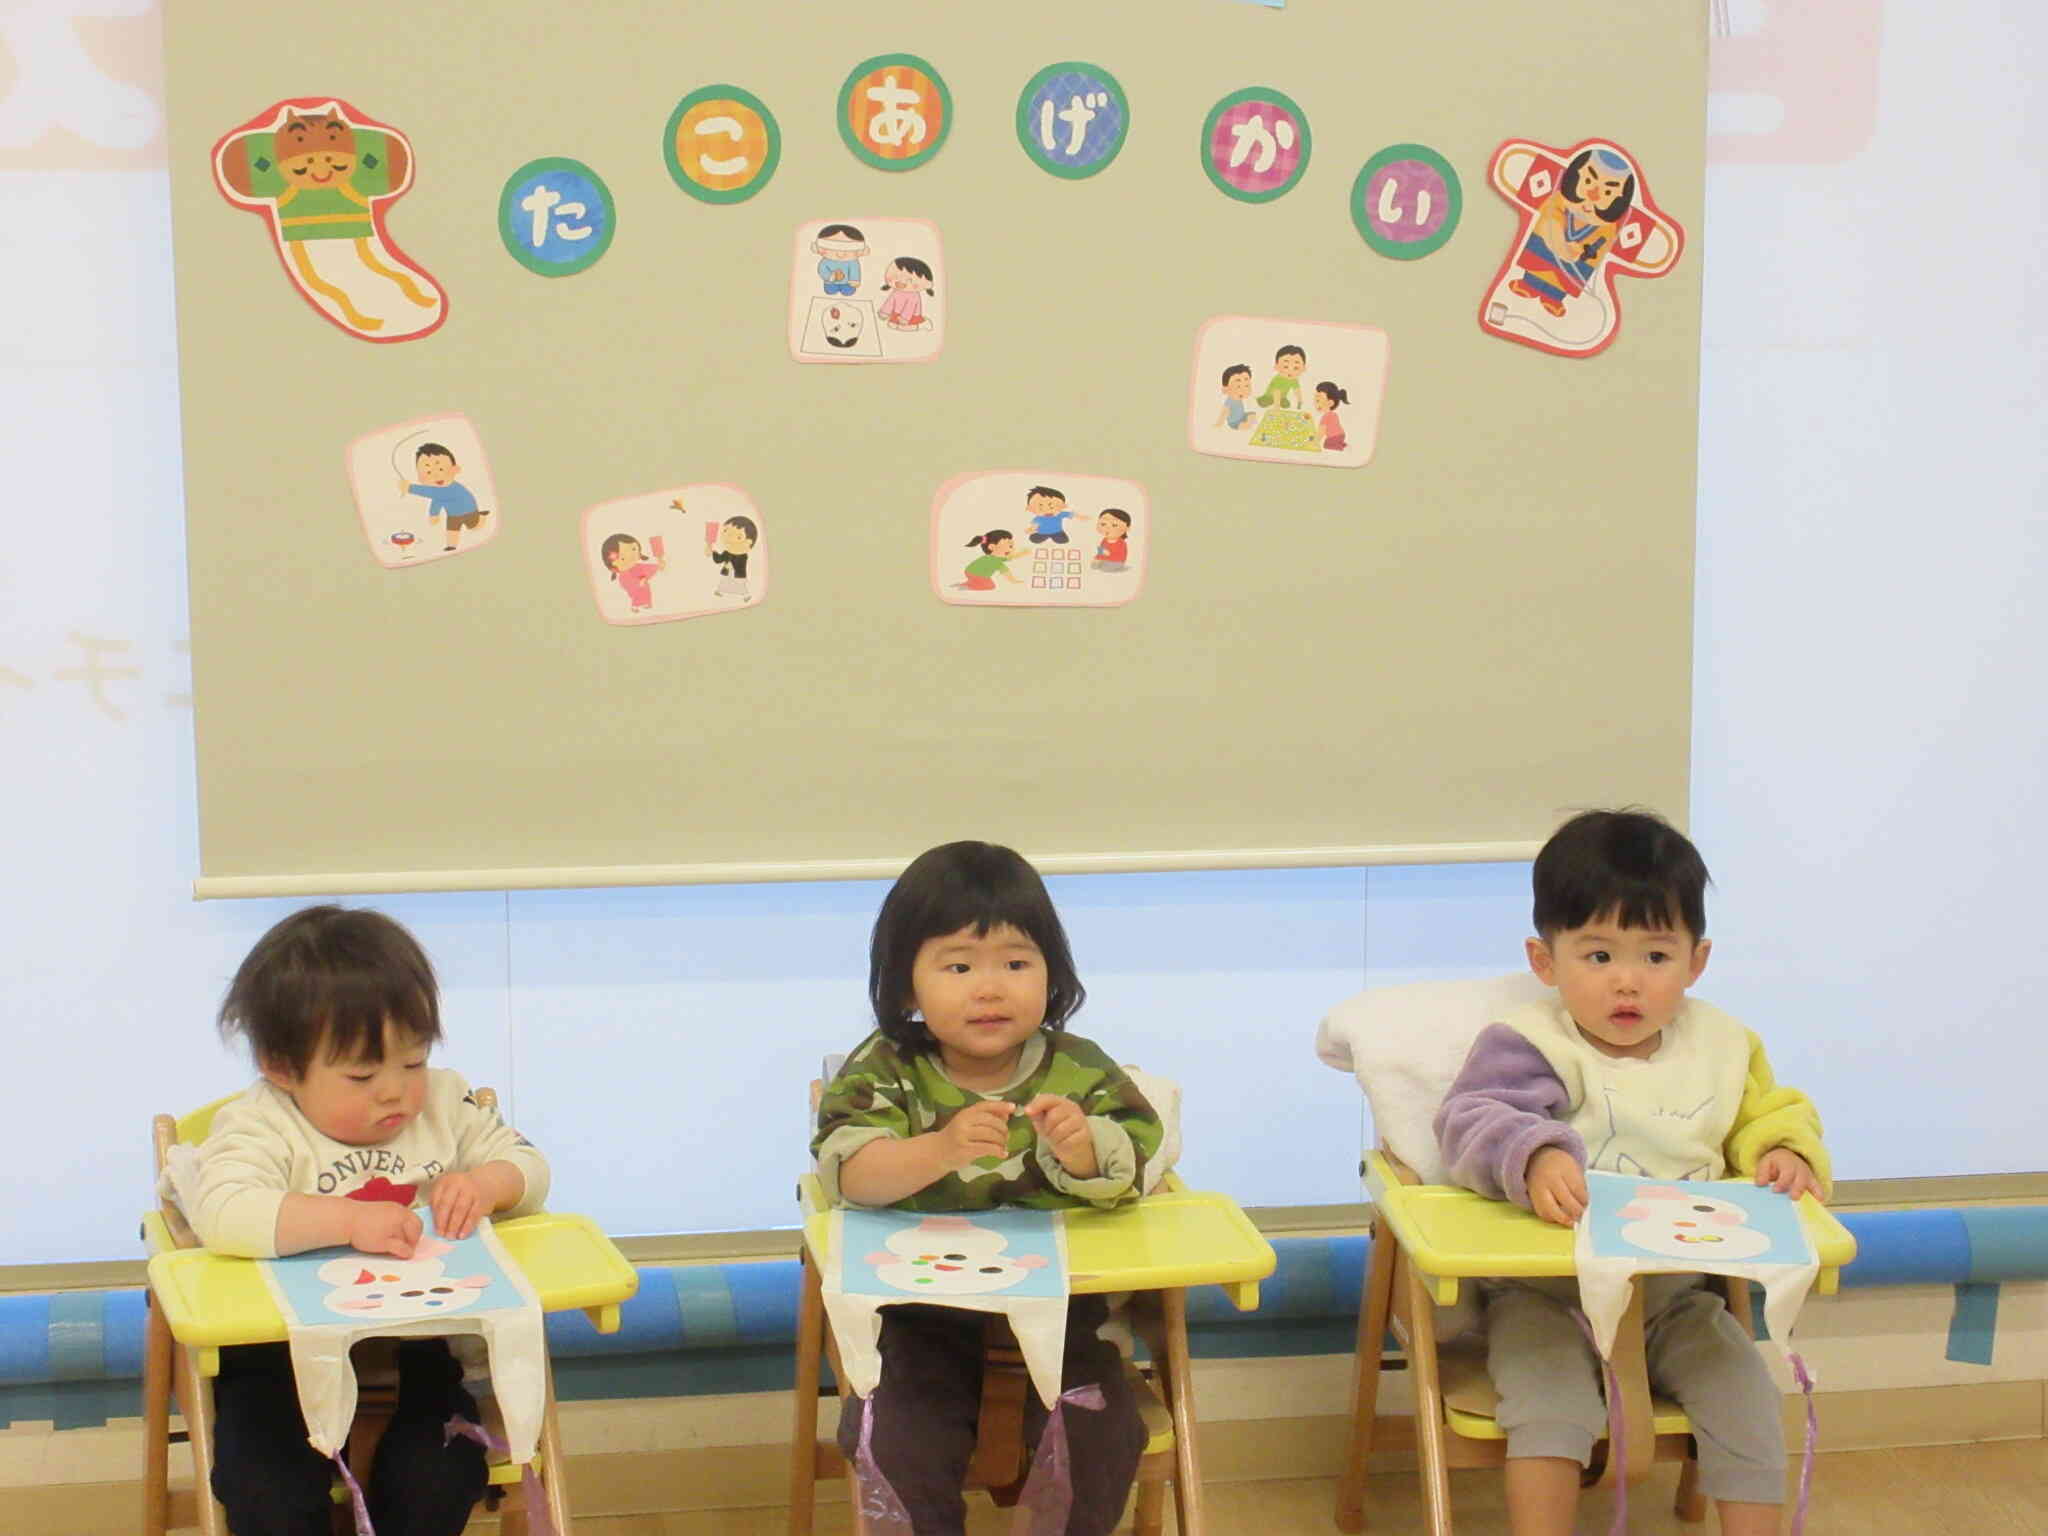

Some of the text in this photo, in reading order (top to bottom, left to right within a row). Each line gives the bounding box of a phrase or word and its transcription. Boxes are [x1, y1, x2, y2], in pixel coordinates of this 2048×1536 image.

[521, 75, 1431, 247] たこあげかい
[317, 1149, 444, 1194] ONVERE
